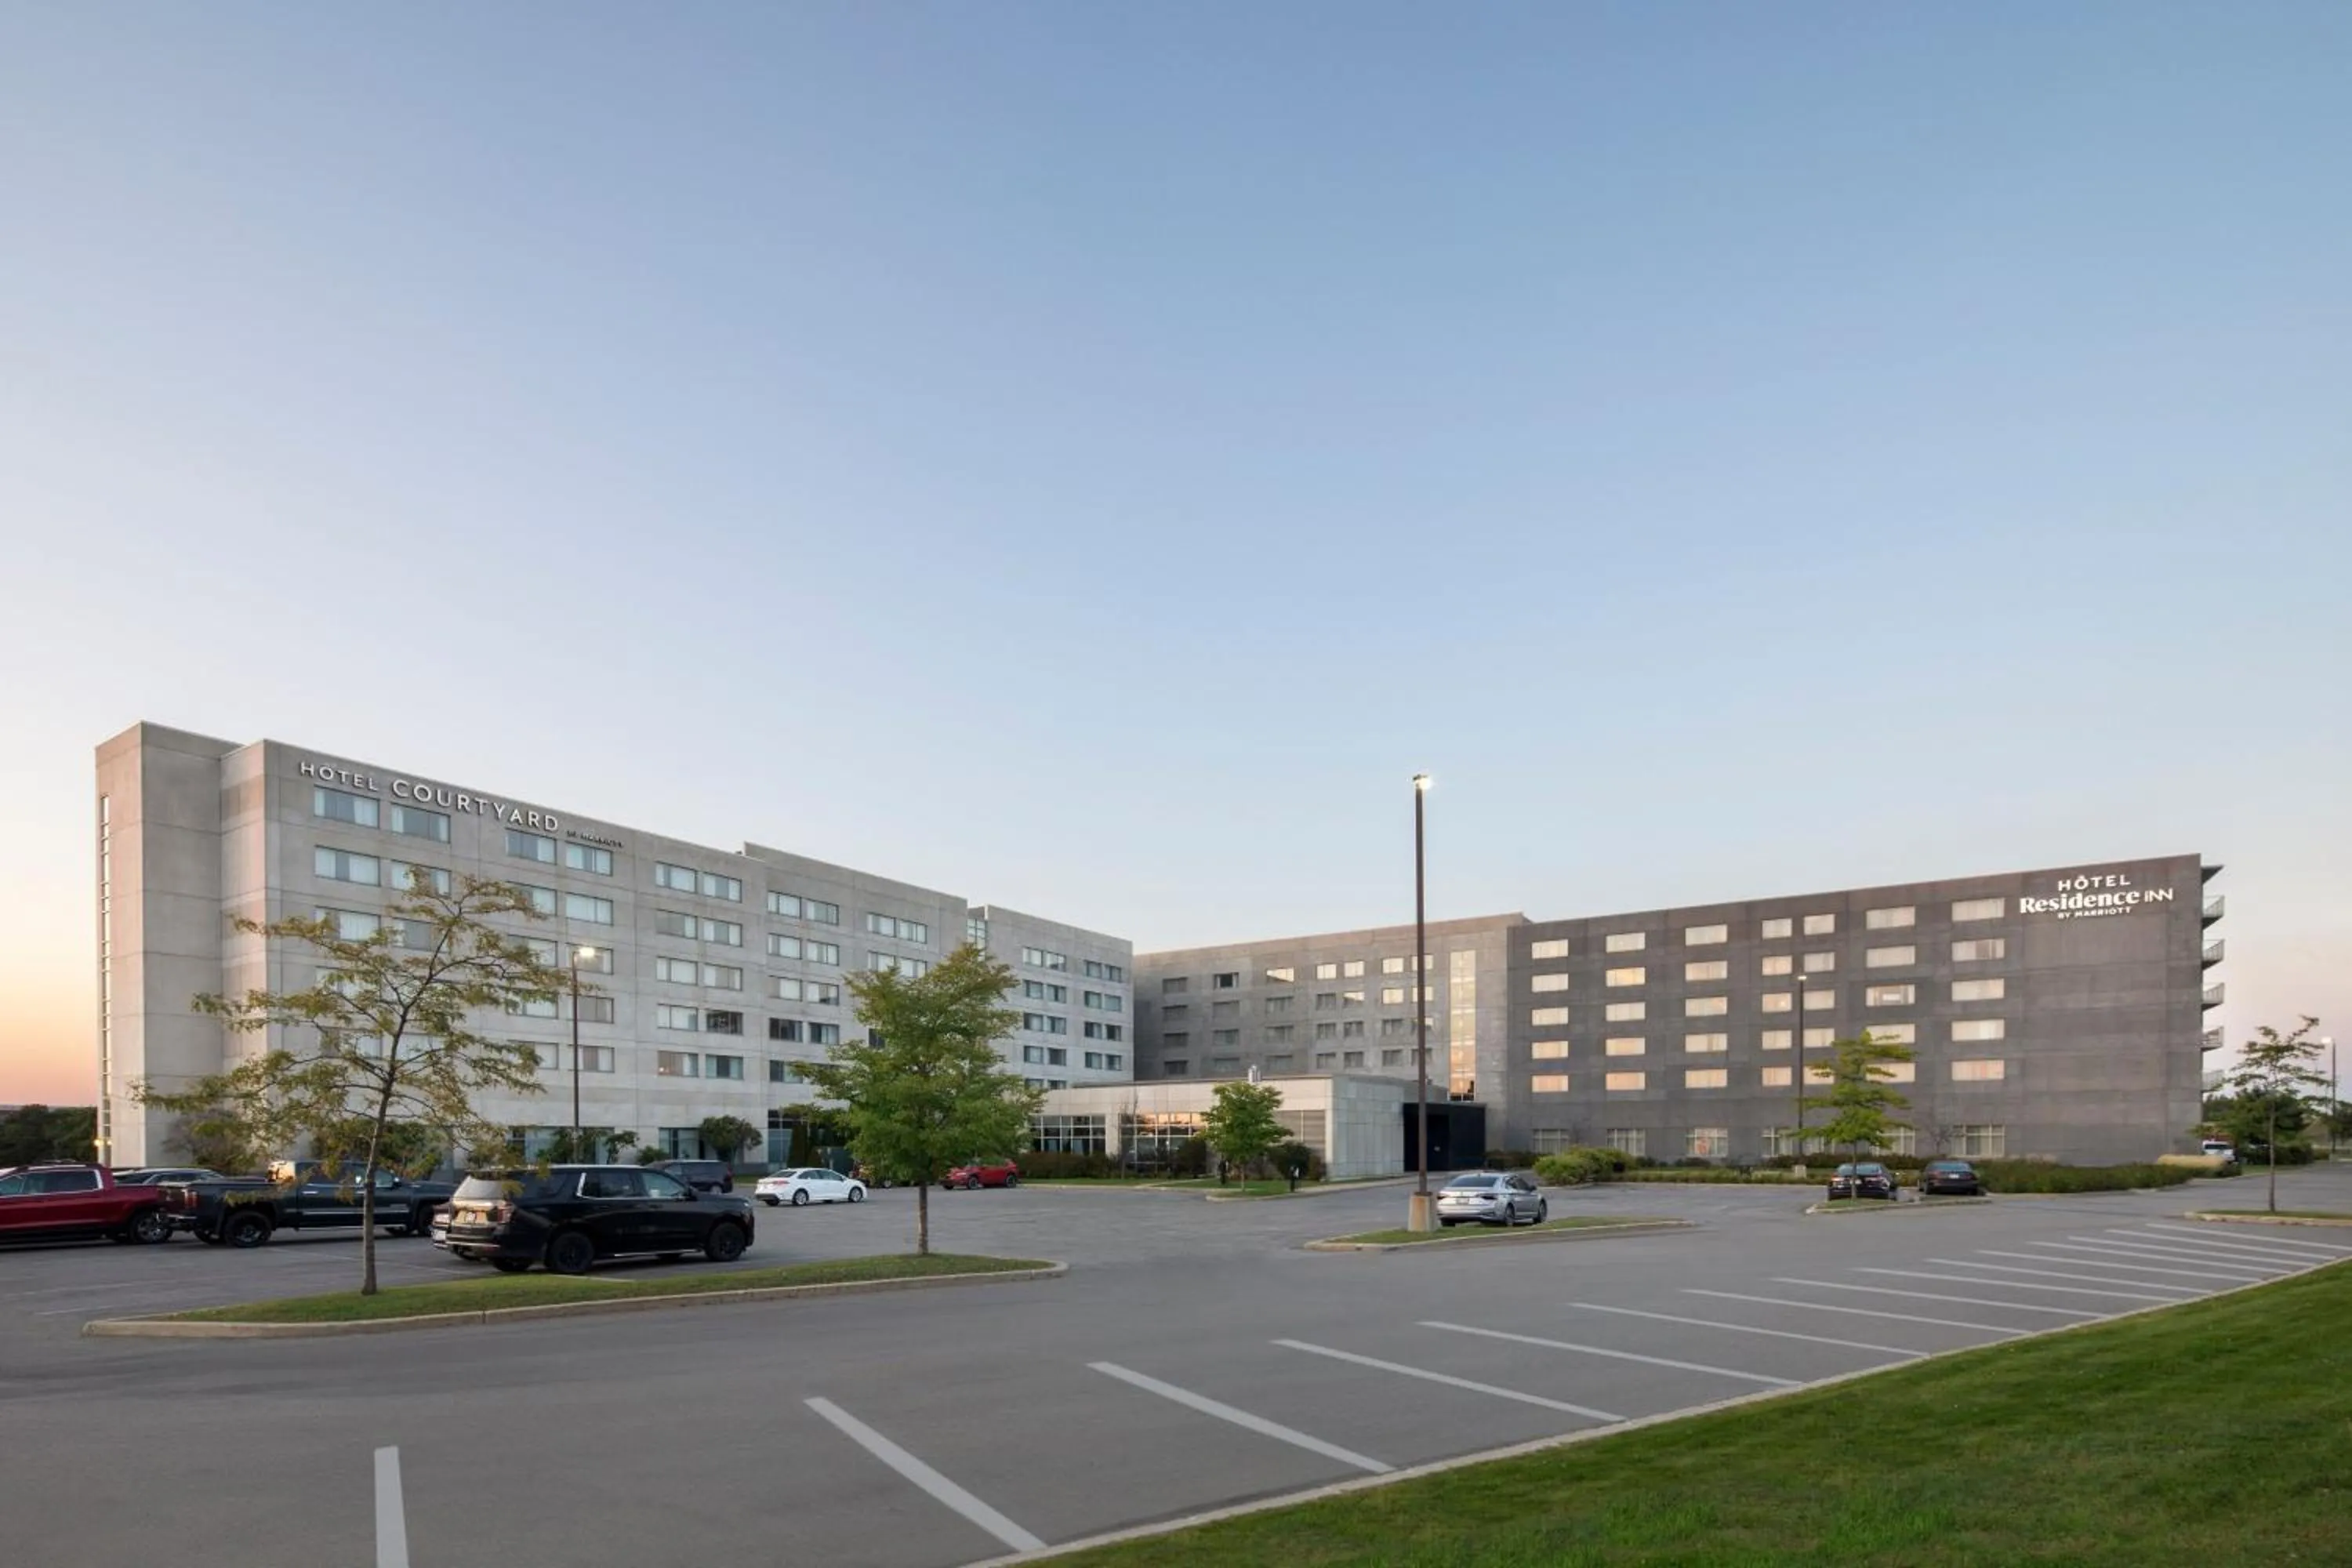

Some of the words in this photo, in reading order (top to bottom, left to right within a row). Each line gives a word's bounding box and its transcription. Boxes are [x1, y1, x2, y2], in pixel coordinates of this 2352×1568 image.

[393, 779, 557, 831] COURTYARD
[2020, 891, 2140, 913] Residence
[2144, 887, 2173, 902] INN
[2074, 906, 2131, 917] MARRIOTT
